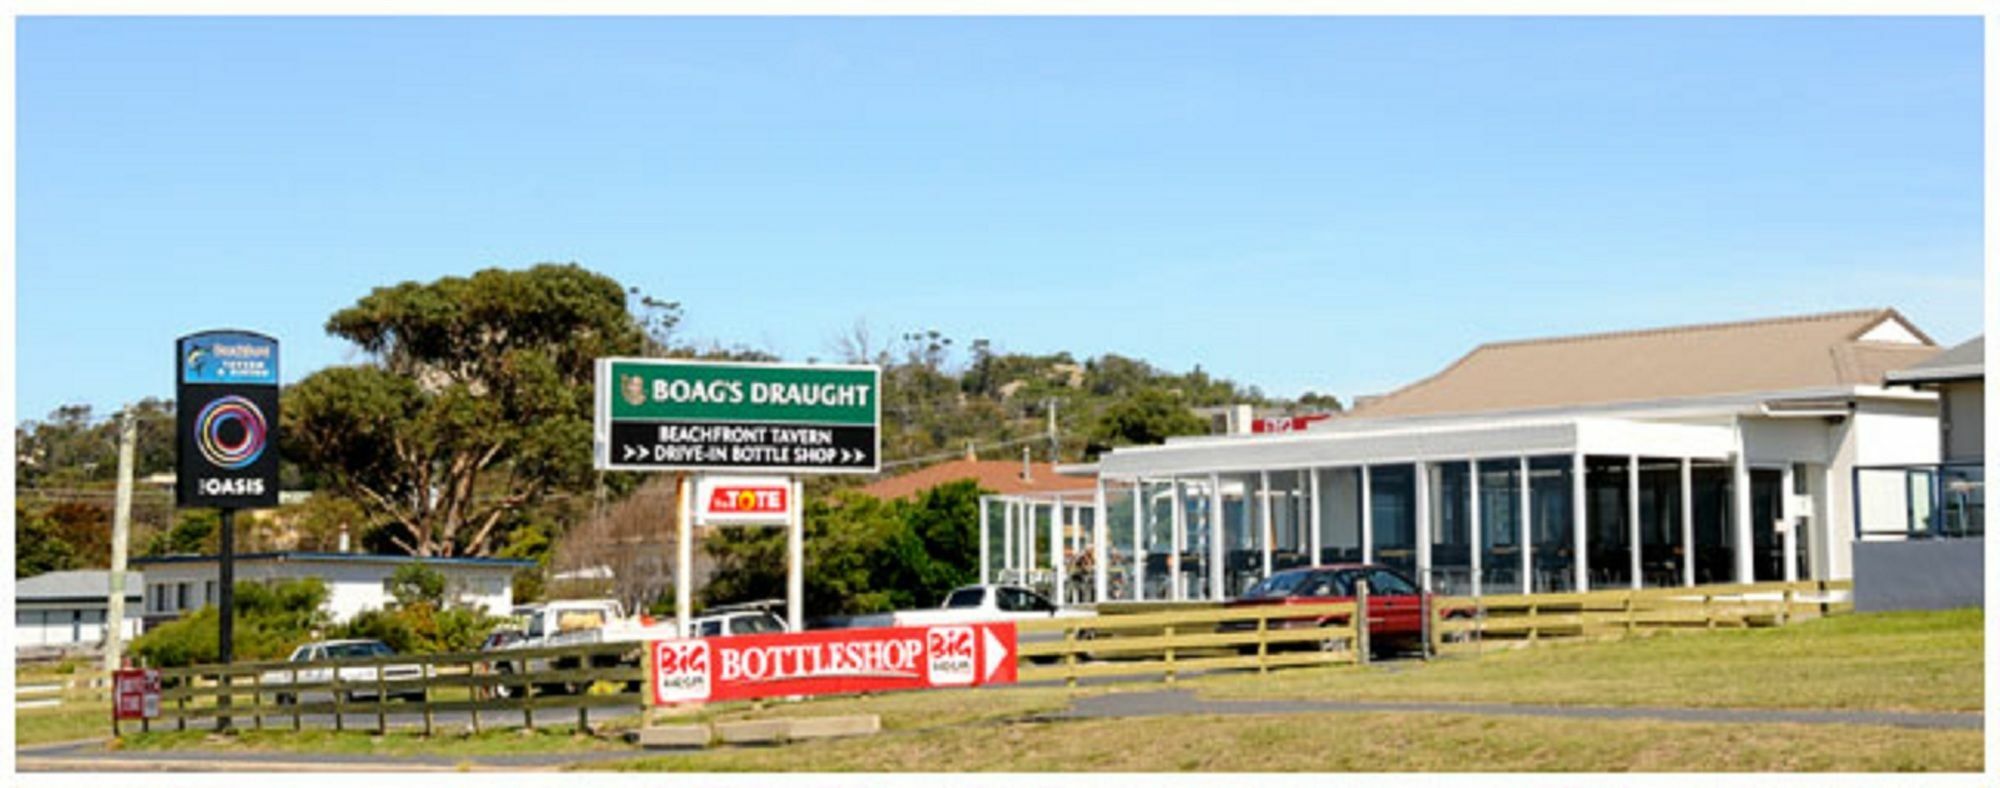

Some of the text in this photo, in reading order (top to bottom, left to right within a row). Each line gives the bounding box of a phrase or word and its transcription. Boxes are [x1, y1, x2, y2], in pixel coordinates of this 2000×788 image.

[652, 379, 870, 406] BOAG'S DRAUGHT
[658, 426, 832, 444] BEACHFRONT TAVERN
[654, 445, 836, 463] DRIVE-IN BOTTLE SHOP
[206, 478, 265, 495] OASIS
[725, 490, 781, 510] TOTE
[720, 639, 922, 680] BOTTLESHOP
